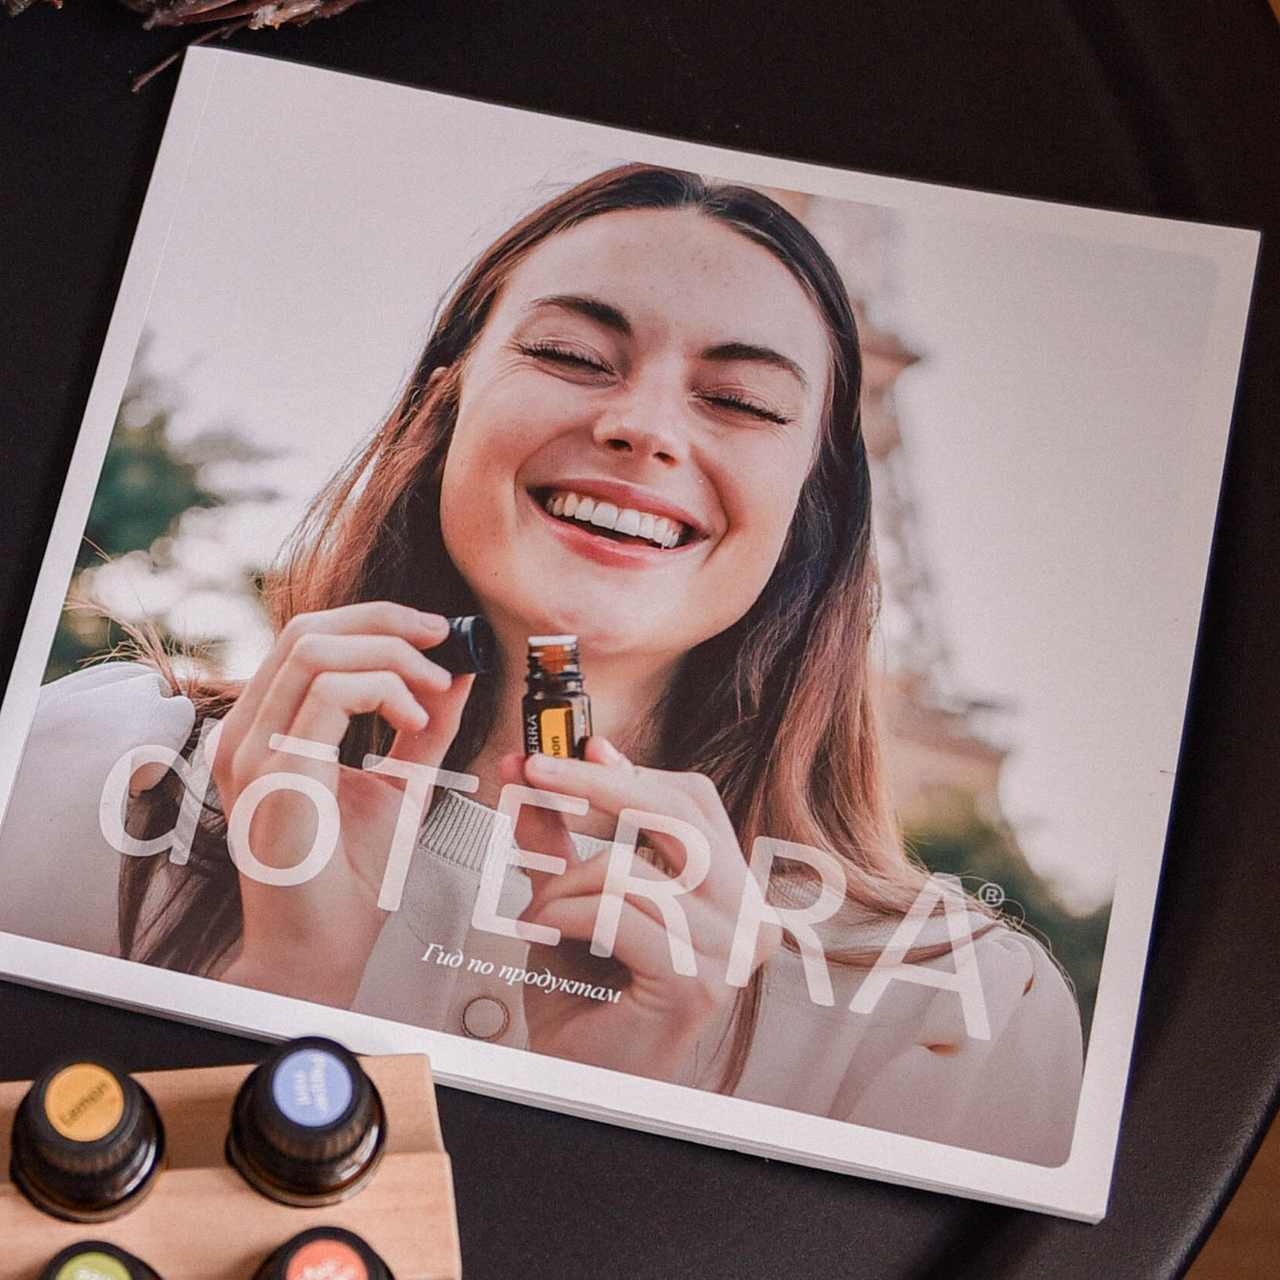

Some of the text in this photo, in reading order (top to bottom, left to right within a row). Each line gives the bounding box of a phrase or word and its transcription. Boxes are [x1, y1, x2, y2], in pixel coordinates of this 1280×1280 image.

[421, 942, 622, 1005] Гид по продуктам
[57, 1079, 109, 1128] Lemon
